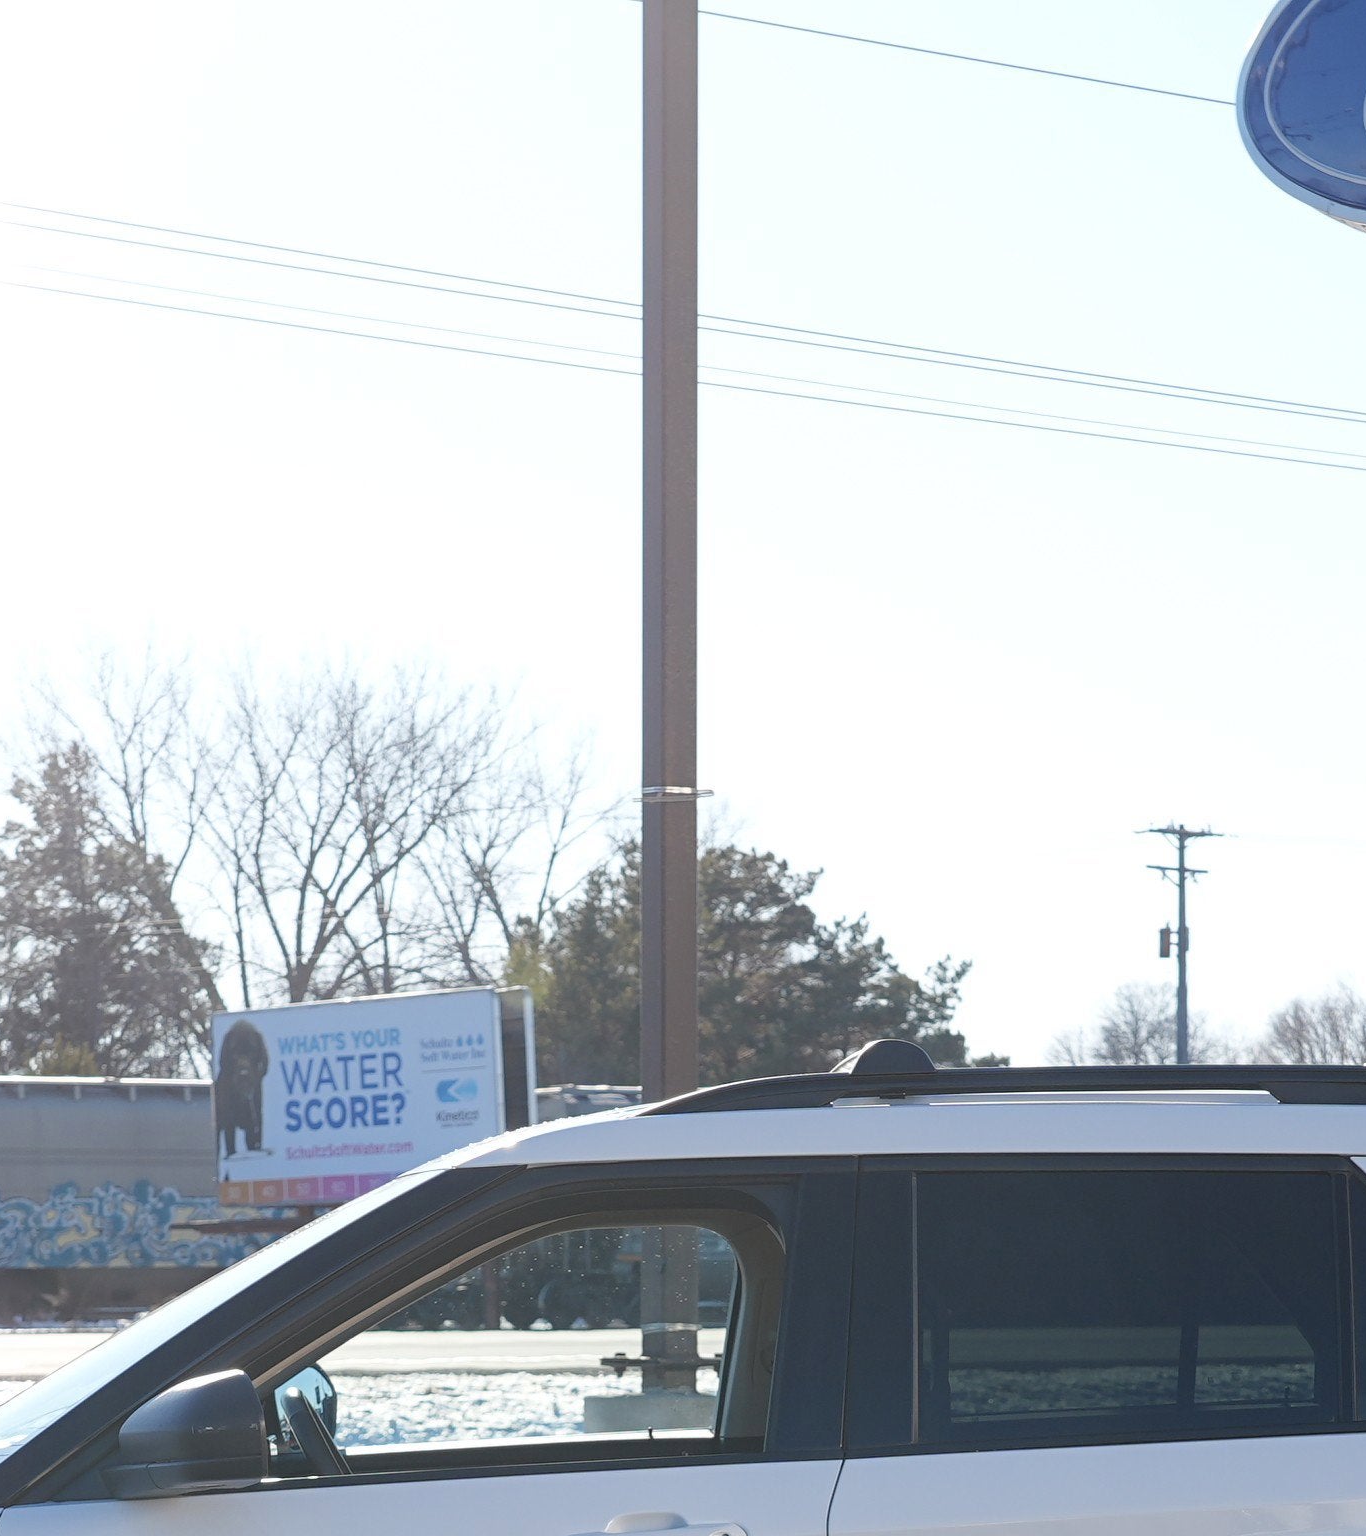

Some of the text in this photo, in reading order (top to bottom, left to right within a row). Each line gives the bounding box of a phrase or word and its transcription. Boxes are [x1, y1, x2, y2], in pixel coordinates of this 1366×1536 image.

[278, 1028, 401, 1055] WHAT'S YOUR
[280, 1052, 404, 1095] WATER
[285, 1092, 406, 1133] SCORE?
